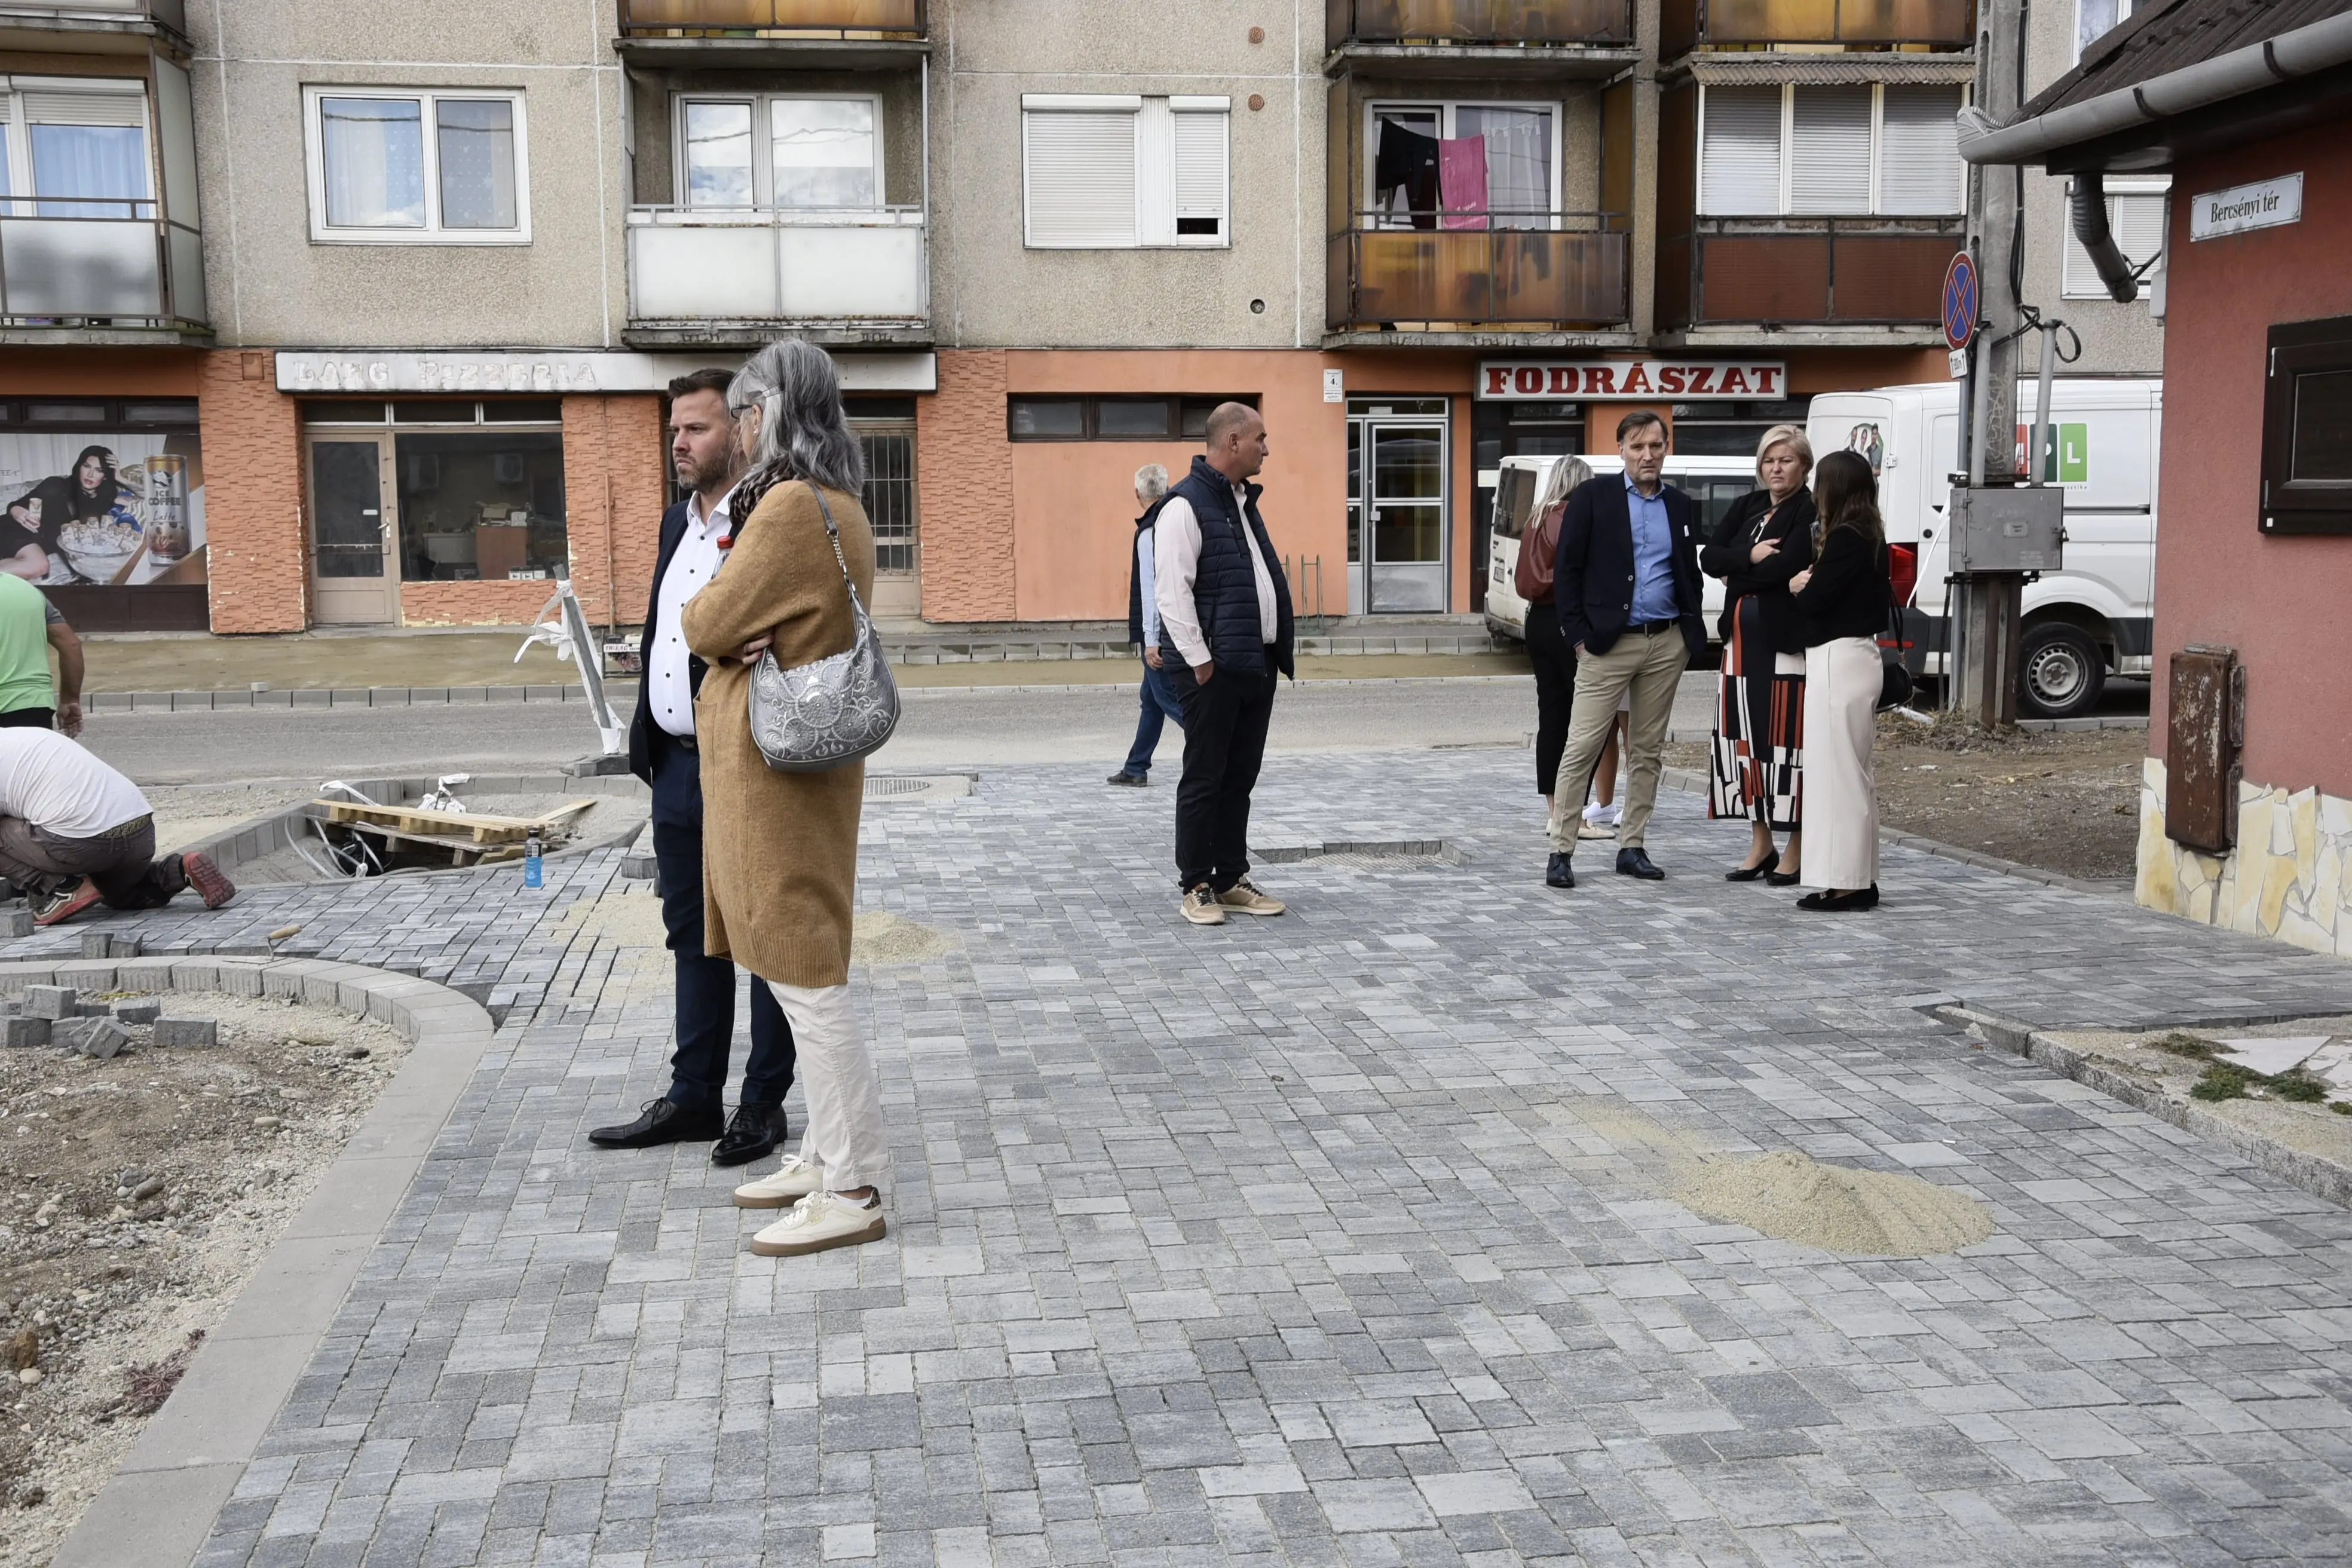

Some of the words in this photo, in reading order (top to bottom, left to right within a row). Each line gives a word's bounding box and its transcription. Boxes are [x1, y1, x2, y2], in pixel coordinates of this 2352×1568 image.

[2210, 193, 2260, 223] Bercsényi
[2263, 189, 2280, 213] tér
[1485, 362, 1782, 394] FODRÁSZAT
[148, 497, 181, 506] COFFEE
[153, 510, 176, 521] Latte
